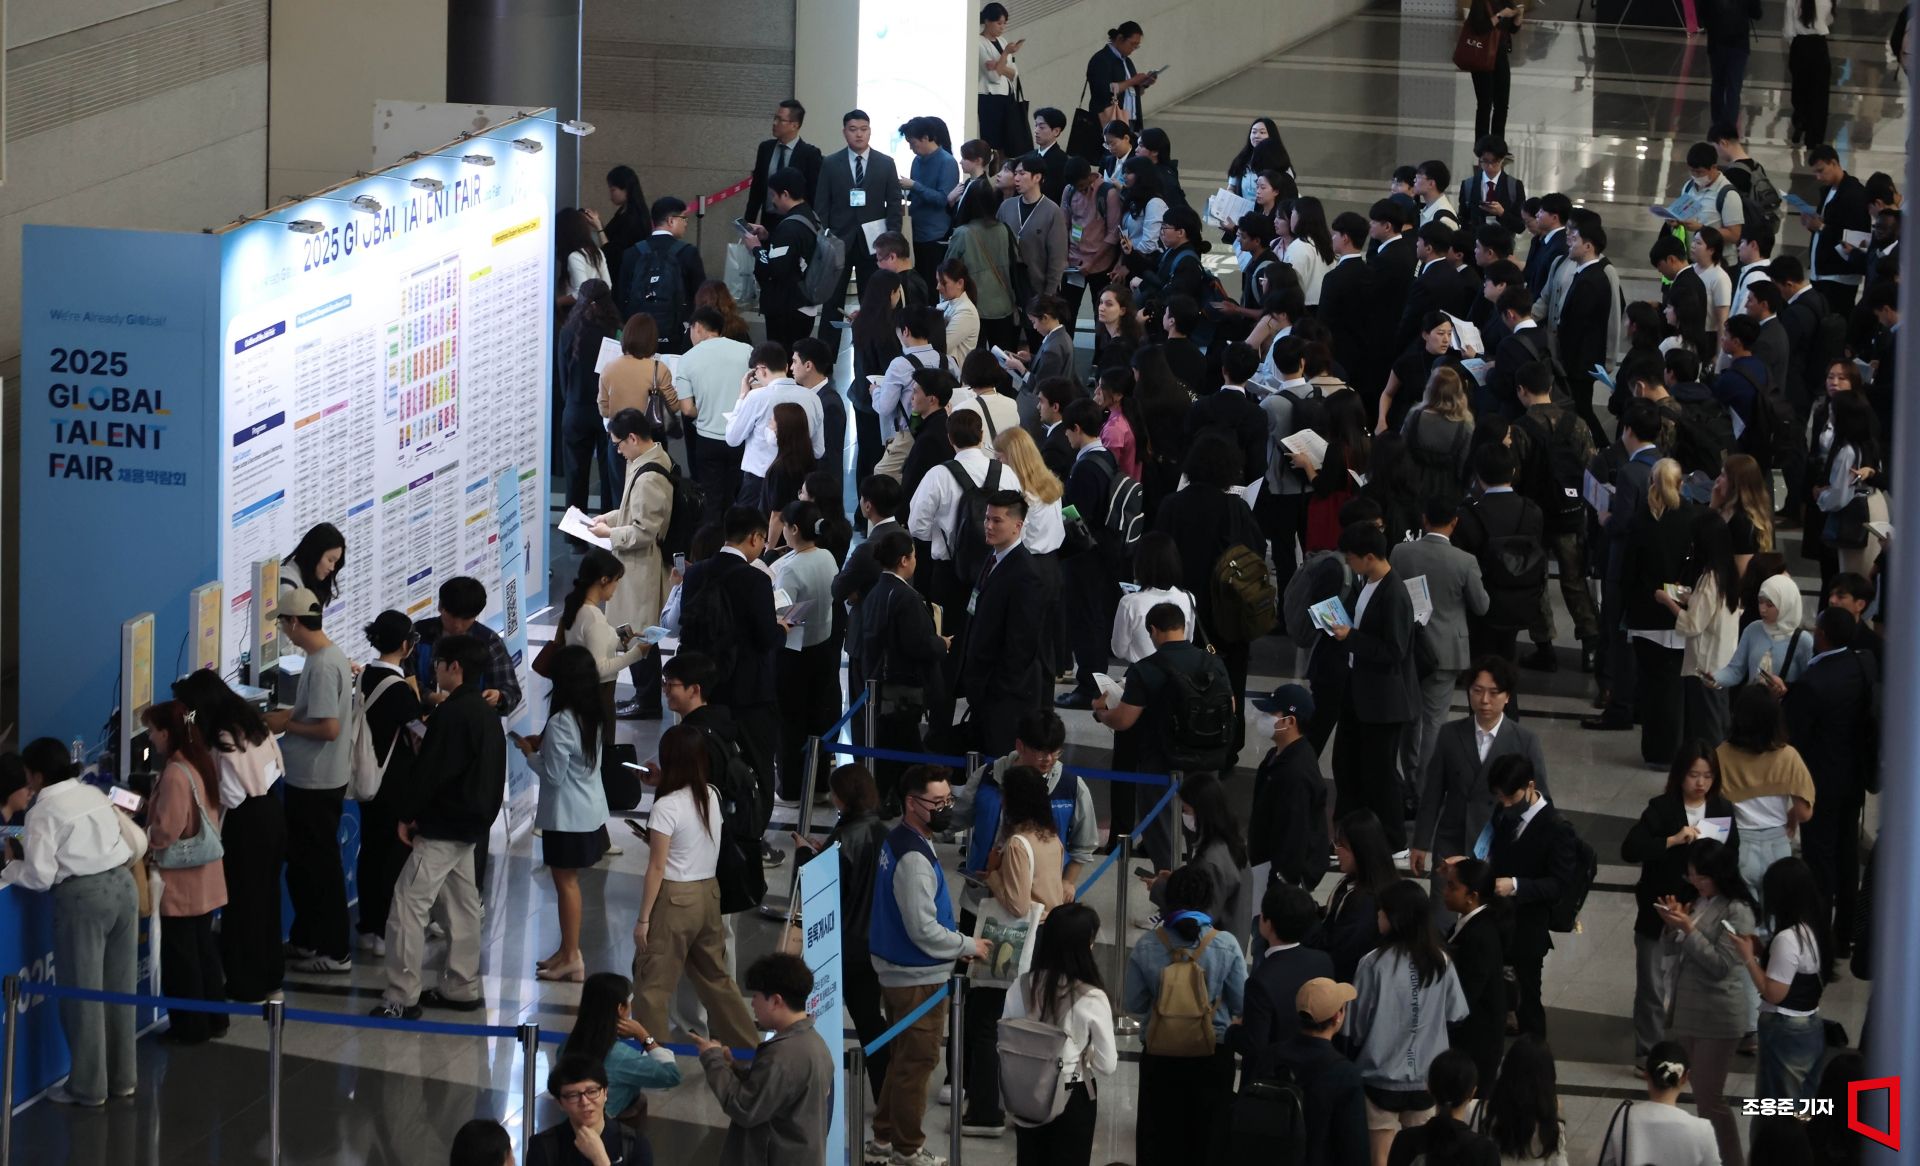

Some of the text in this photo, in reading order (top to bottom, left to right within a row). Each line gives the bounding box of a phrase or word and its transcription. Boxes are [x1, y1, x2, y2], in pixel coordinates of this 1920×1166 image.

[304, 226, 340, 272] 2025
[455, 174, 481, 214] FAIR
[82, 311, 124, 326] Already
[50, 347, 128, 377] 2025
[48, 383, 172, 415] GLOBAL
[49, 418, 167, 450] TALENT
[49, 453, 113, 481] FAIR
